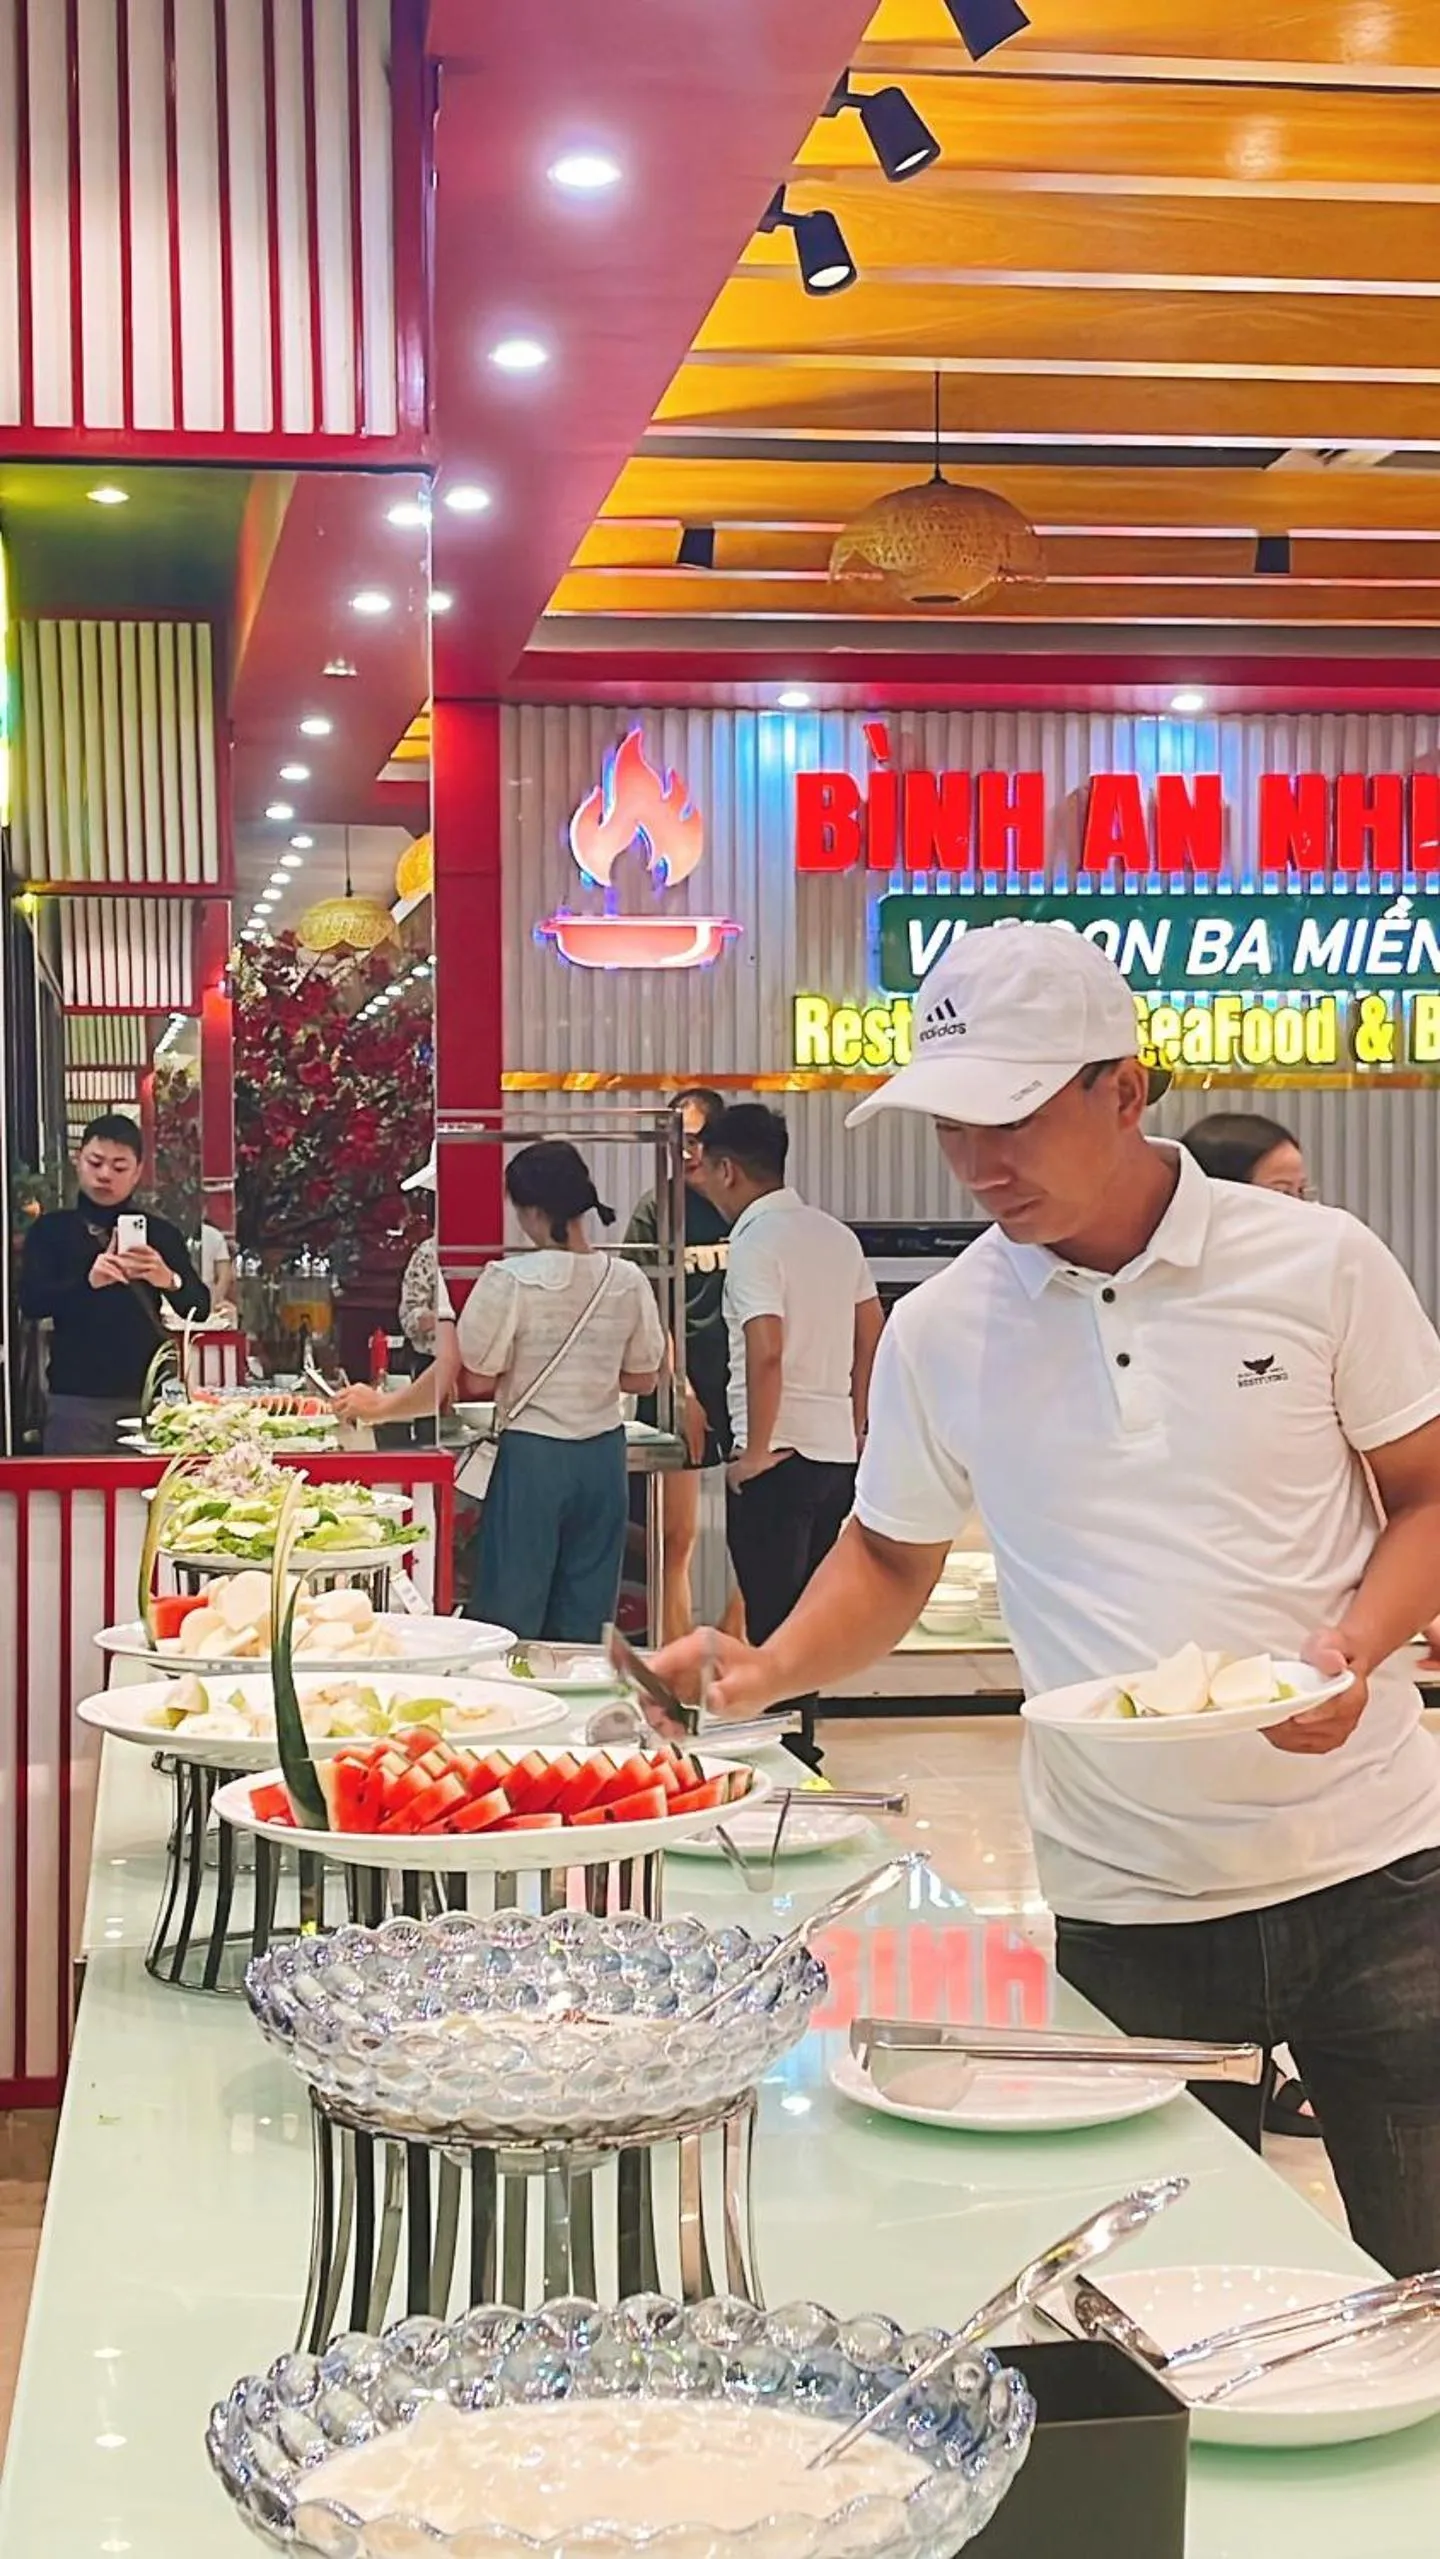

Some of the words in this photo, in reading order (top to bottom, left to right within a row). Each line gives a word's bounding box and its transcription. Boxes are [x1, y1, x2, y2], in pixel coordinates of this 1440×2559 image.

[795, 722, 1045, 872] BÌNH
[1082, 772, 1222, 872] AN
[1187, 918, 1272, 975] BA
[919, 1022, 967, 1042] adidas
[1354, 994, 1395, 1064] &
